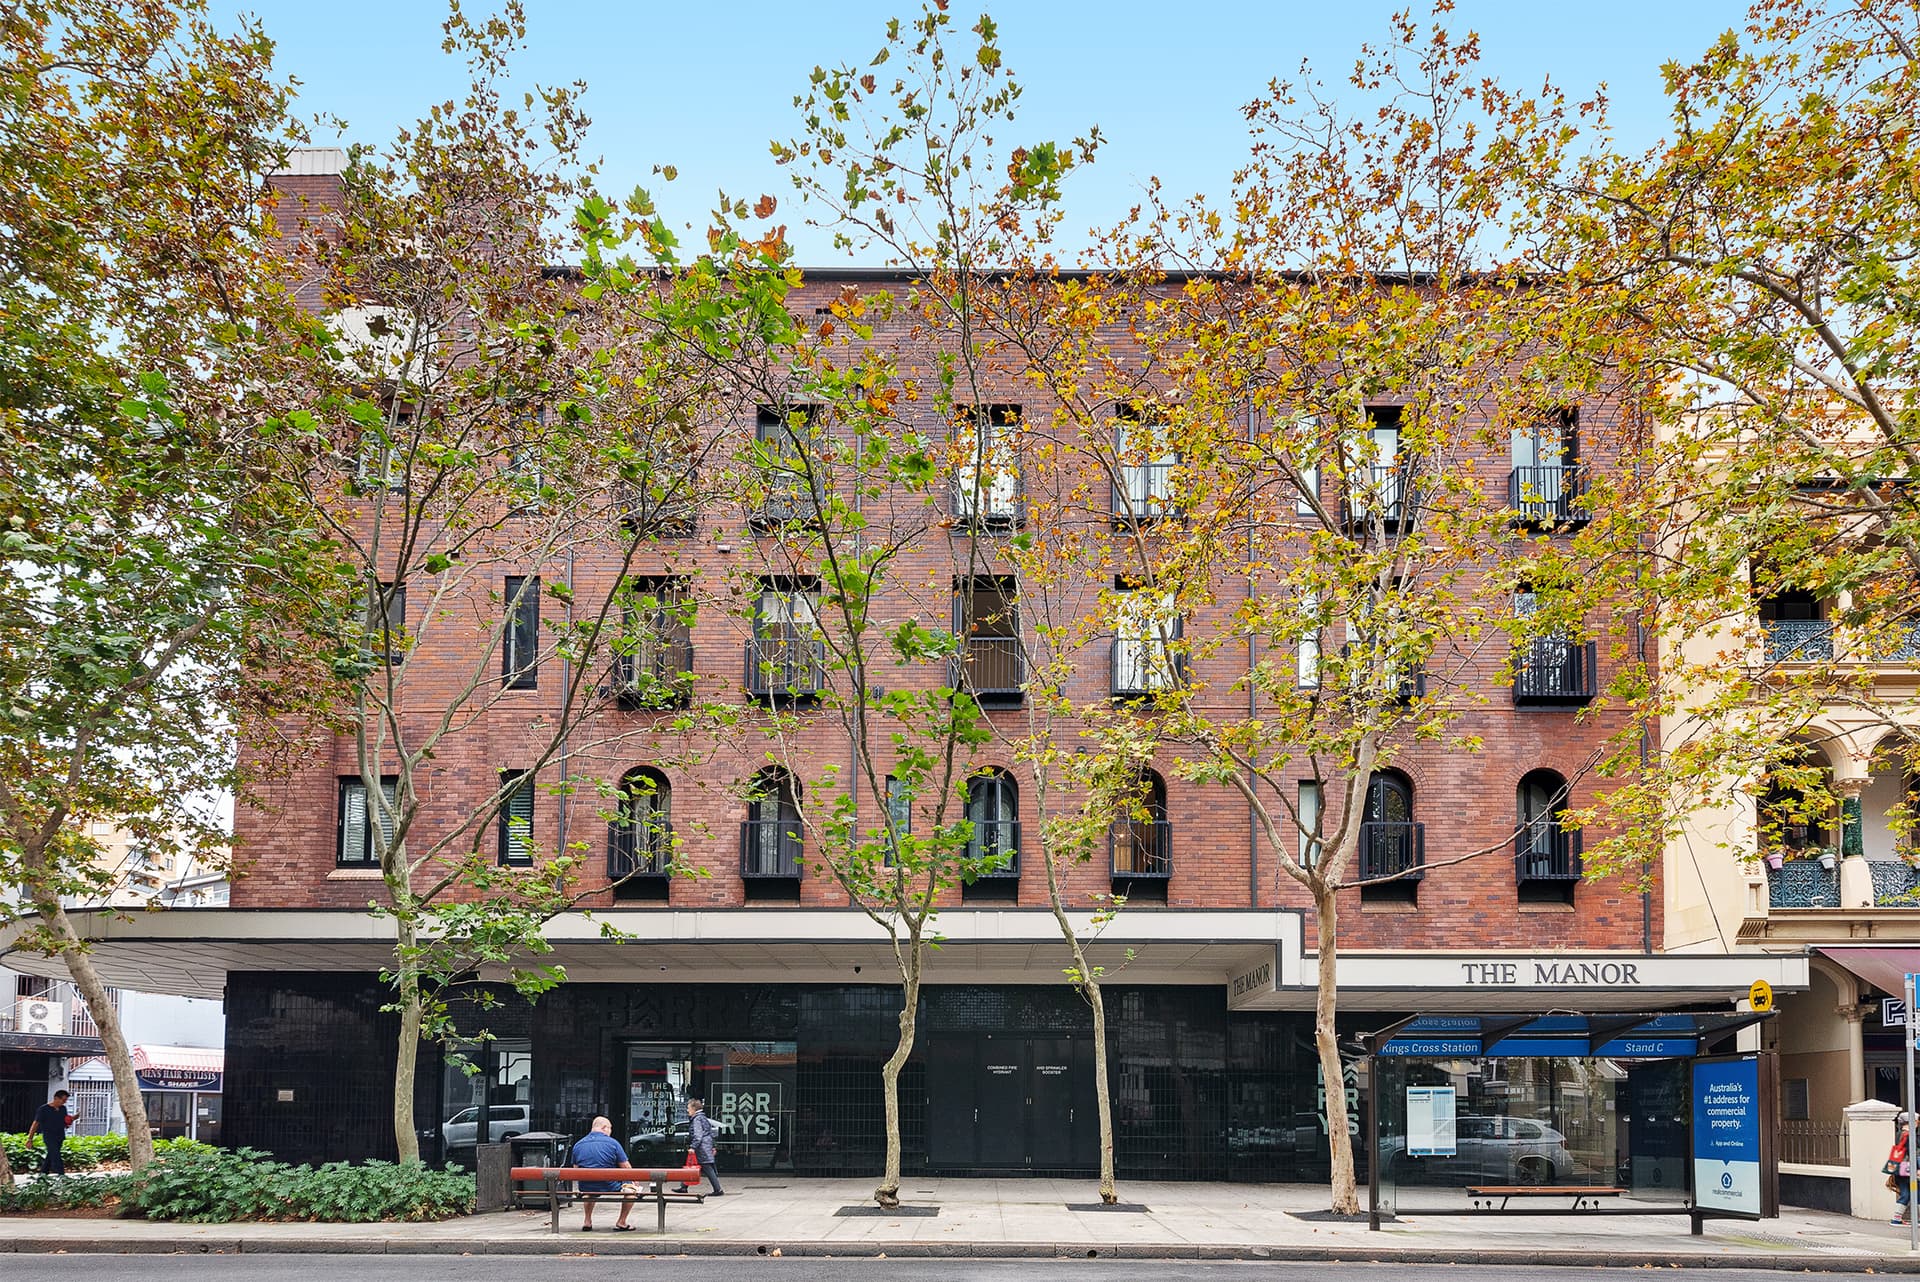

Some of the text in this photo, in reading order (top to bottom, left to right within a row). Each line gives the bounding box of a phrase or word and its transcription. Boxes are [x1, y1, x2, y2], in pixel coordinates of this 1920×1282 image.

[1461, 963, 1641, 985] THE MANOR
[1233, 963, 1271, 997] THE MANOR
[1382, 1042, 1478, 1054] Kings Cross Station
[1624, 1042, 1664, 1053] Stand C
[163, 1070, 182, 1079] HAIR
[183, 1071, 217, 1081] STYLISTS
[650, 1082, 668, 1090] THE
[1709, 1083, 1743, 1092] Australia's
[647, 1091, 671, 1099] BEST
[1703, 1094, 1750, 1104] #1 address for
[1706, 1106, 1746, 1116] commercial
[651, 1118, 667, 1126] THE
[721, 1114, 770, 1135] RYS
[1711, 1119, 1742, 1130] property.
